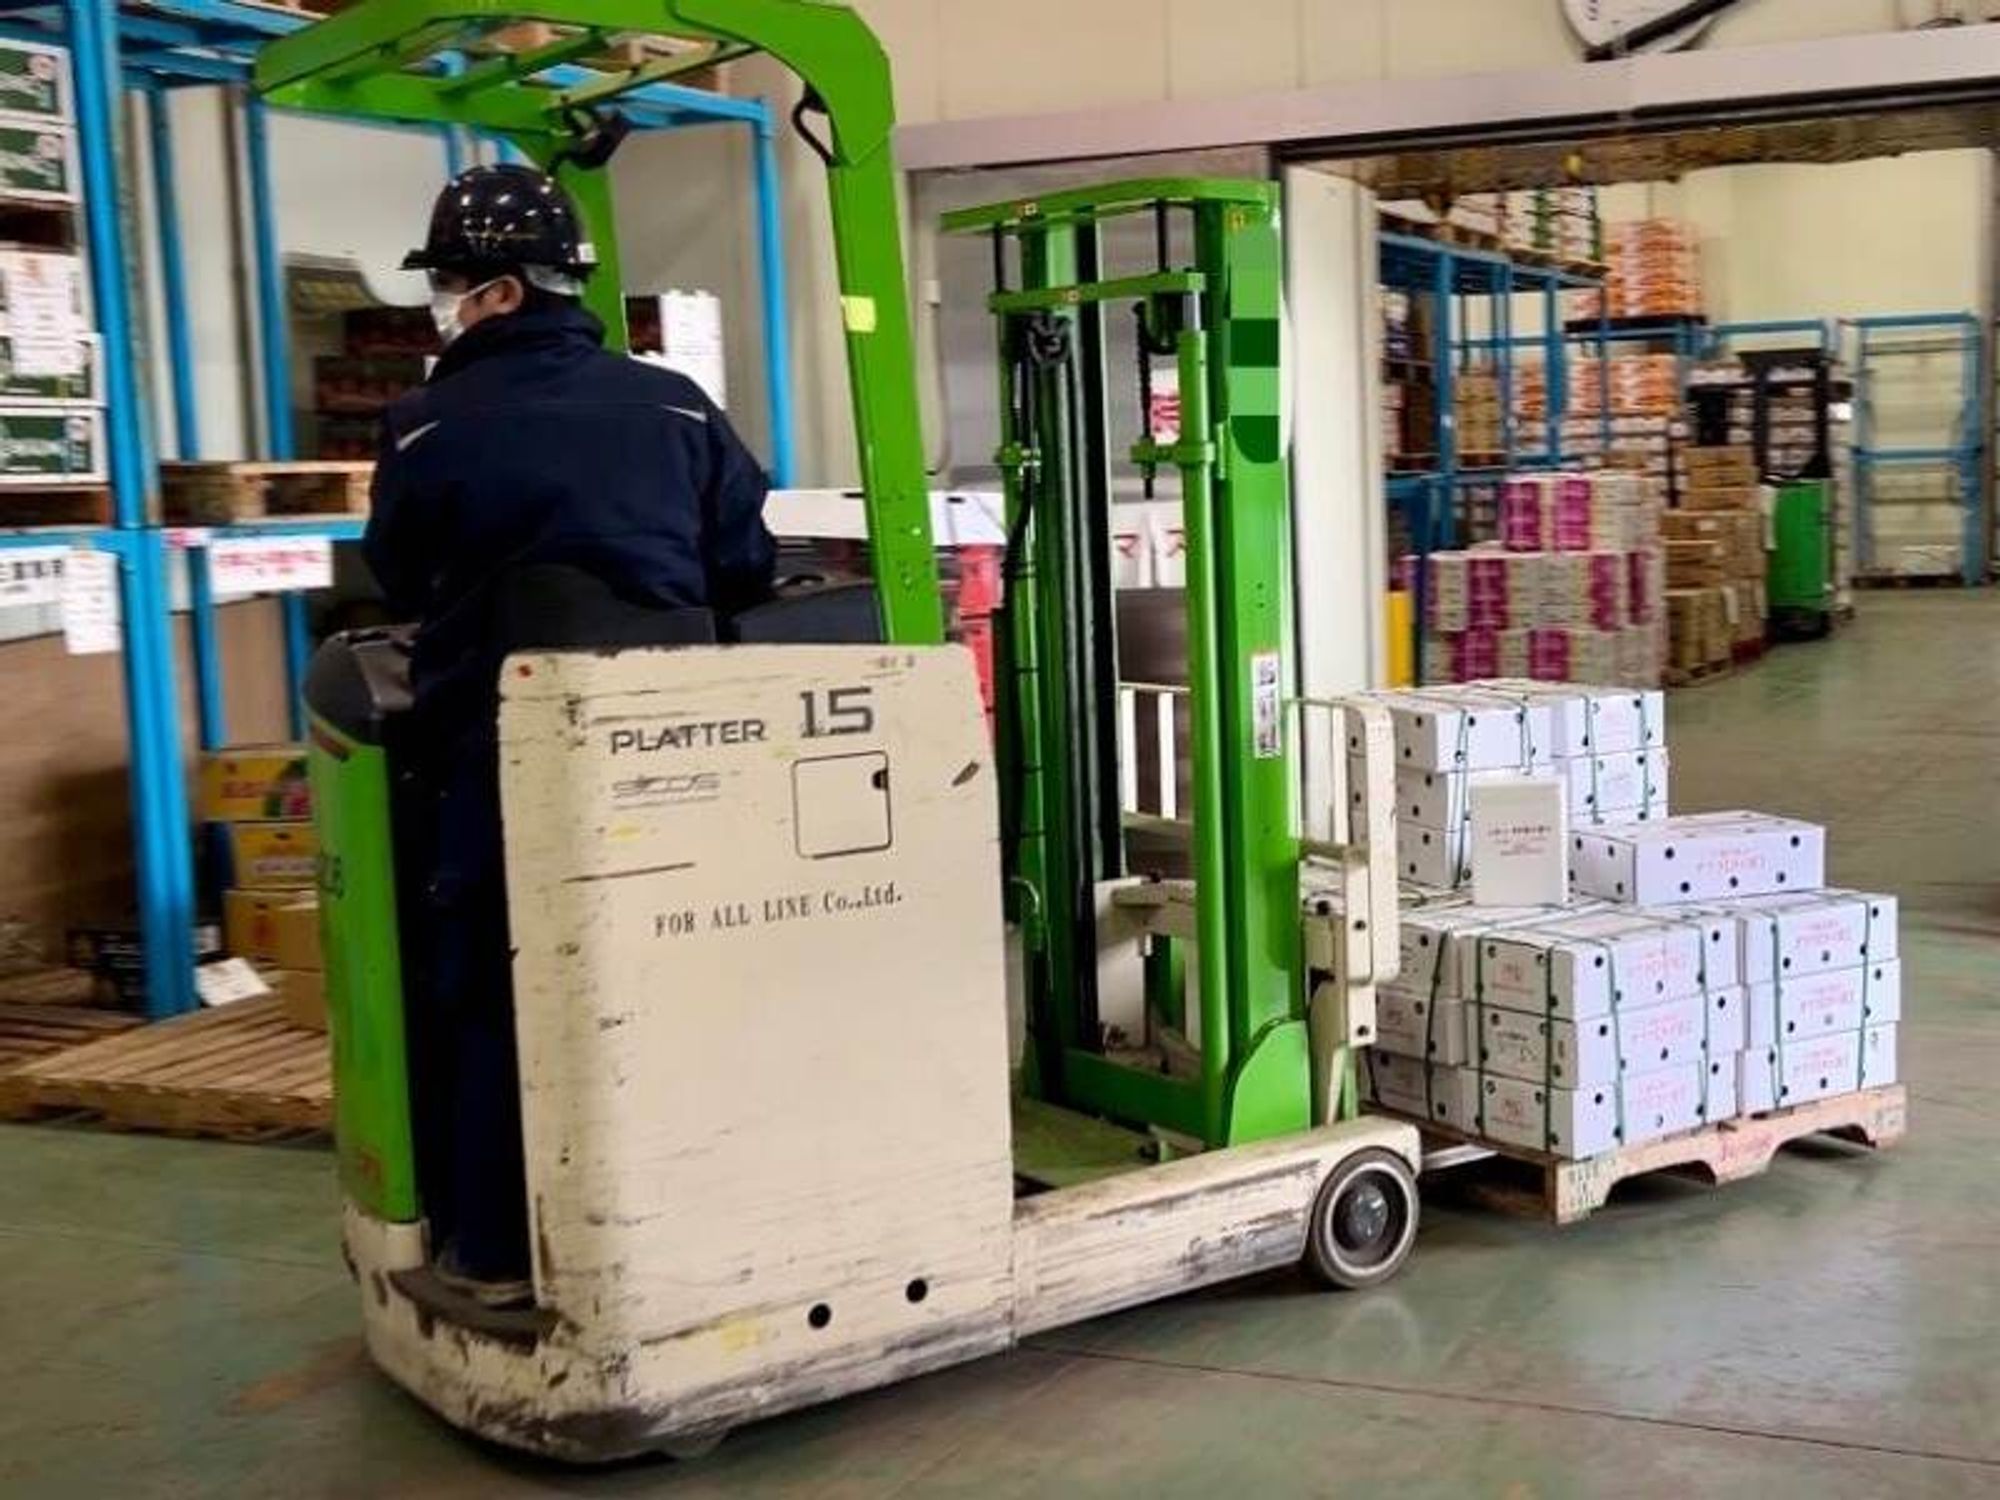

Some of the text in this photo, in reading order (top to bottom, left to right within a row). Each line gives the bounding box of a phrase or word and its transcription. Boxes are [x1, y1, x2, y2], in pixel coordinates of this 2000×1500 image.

[610, 718, 768, 756] PLATTER
[655, 911, 695, 938] FOR
[712, 902, 750, 929] ALL
[763, 895, 812, 923] LINE
